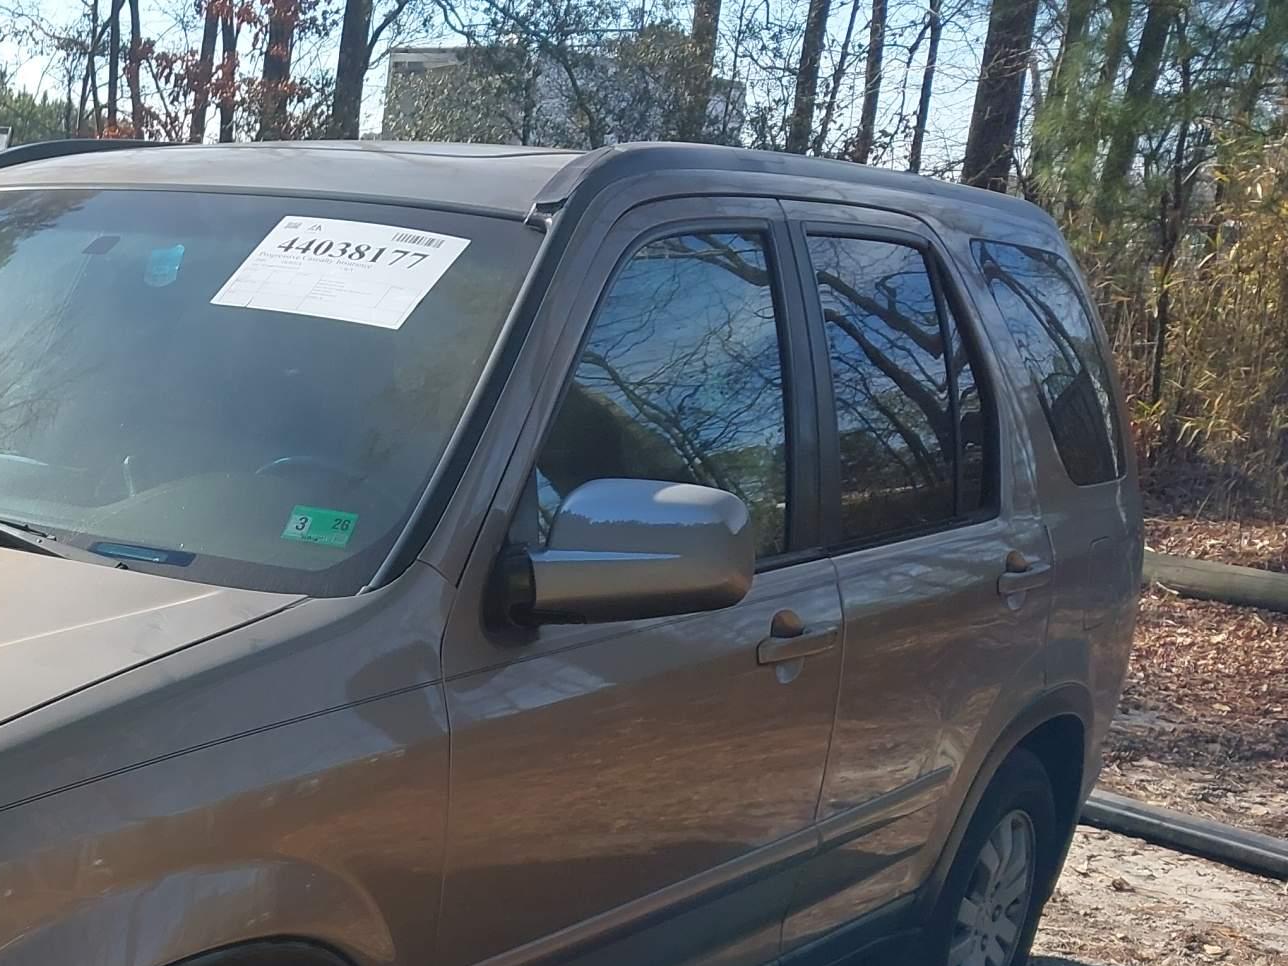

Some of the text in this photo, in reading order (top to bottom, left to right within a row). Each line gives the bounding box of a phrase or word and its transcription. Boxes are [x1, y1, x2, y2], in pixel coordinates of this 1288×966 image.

[277, 236, 431, 270] 44038177
[295, 516, 351, 532] 3 26
